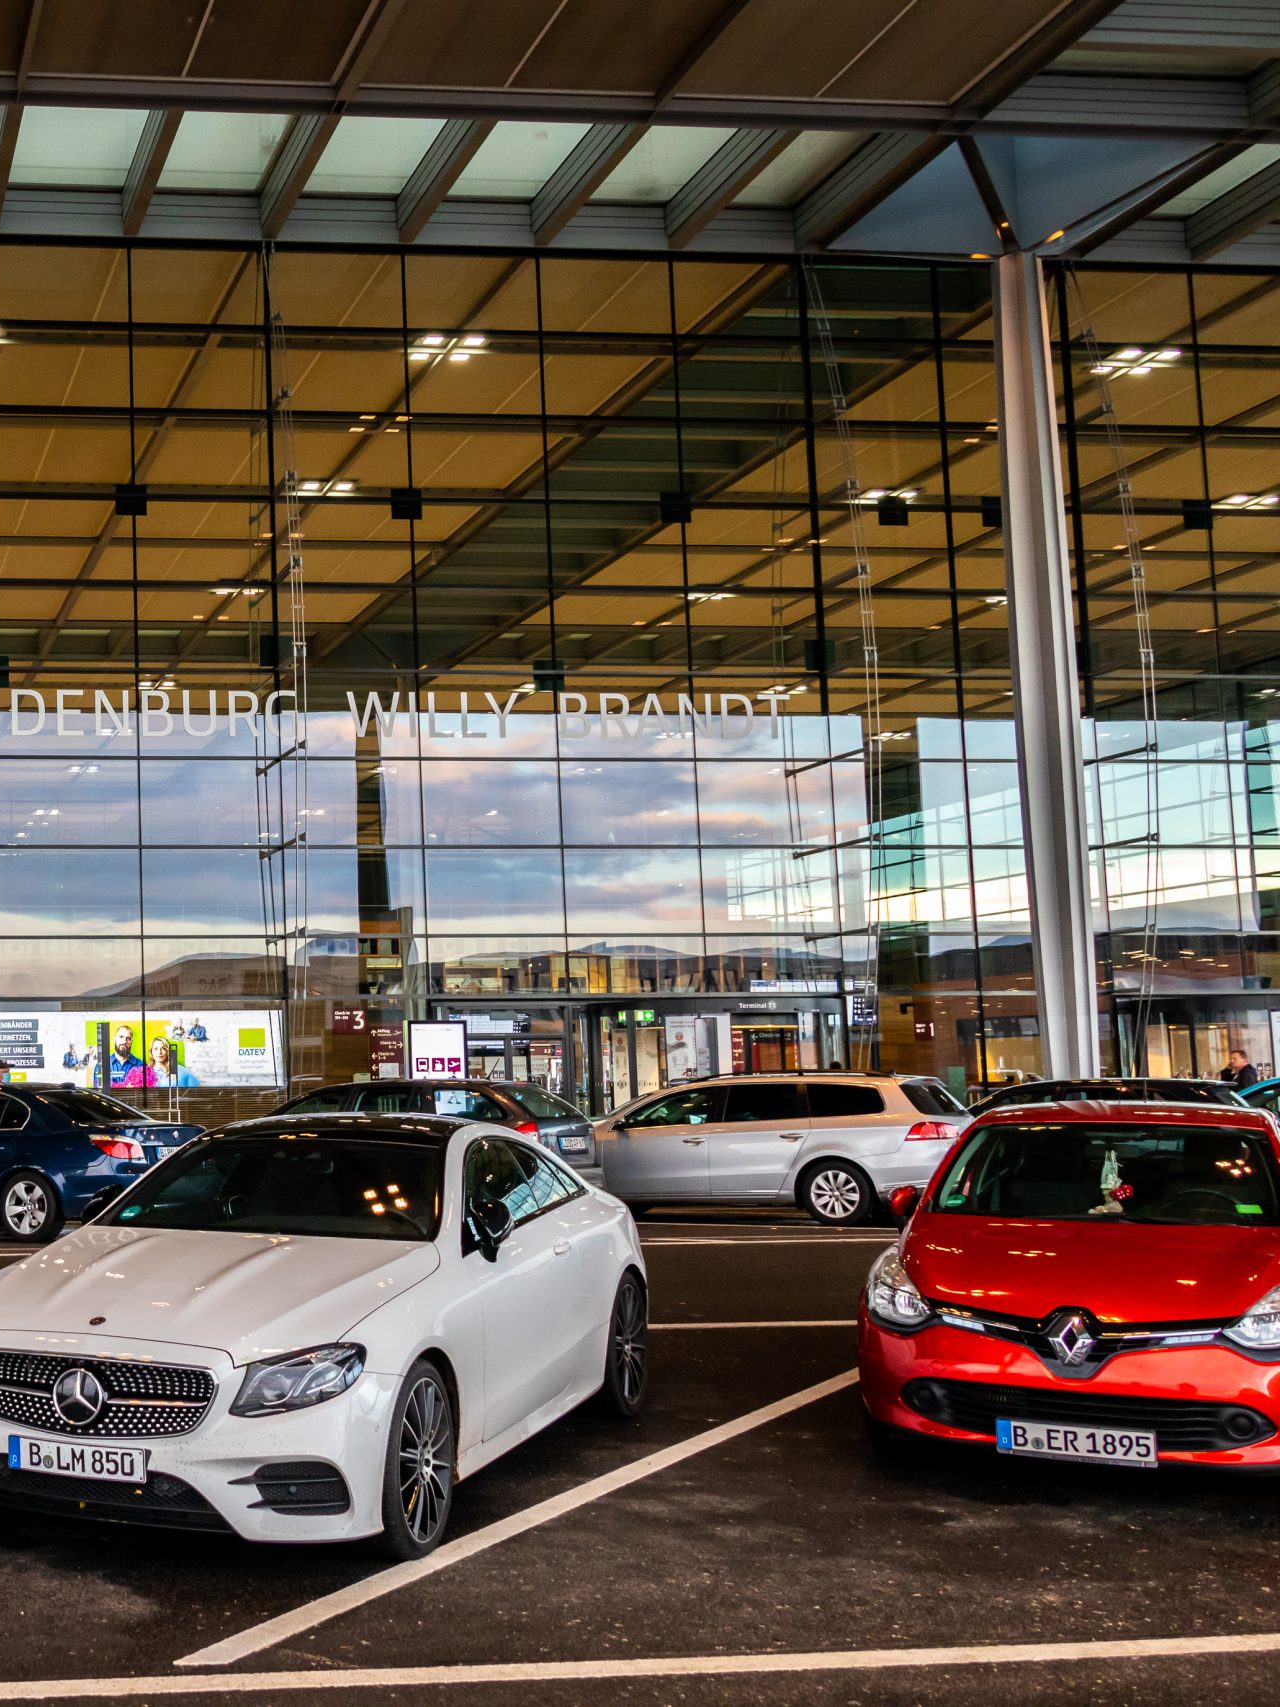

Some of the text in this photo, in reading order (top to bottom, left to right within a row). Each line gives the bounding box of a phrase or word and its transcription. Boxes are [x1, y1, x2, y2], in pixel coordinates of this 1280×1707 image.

[346, 691, 519, 738] WILLY
[559, 693, 790, 739] BRANDT
[353, 1011, 364, 1029] 3
[929, 1022, 935, 1037] 1
[1013, 1425, 1028, 1447] B
[1046, 1428, 1079, 1453] ER
[1086, 1432, 1151, 1458] 1895
[29, 1442, 41, 1466] B
[56, 1446, 85, 1473] LM
[91, 1450, 135, 1476] 850
